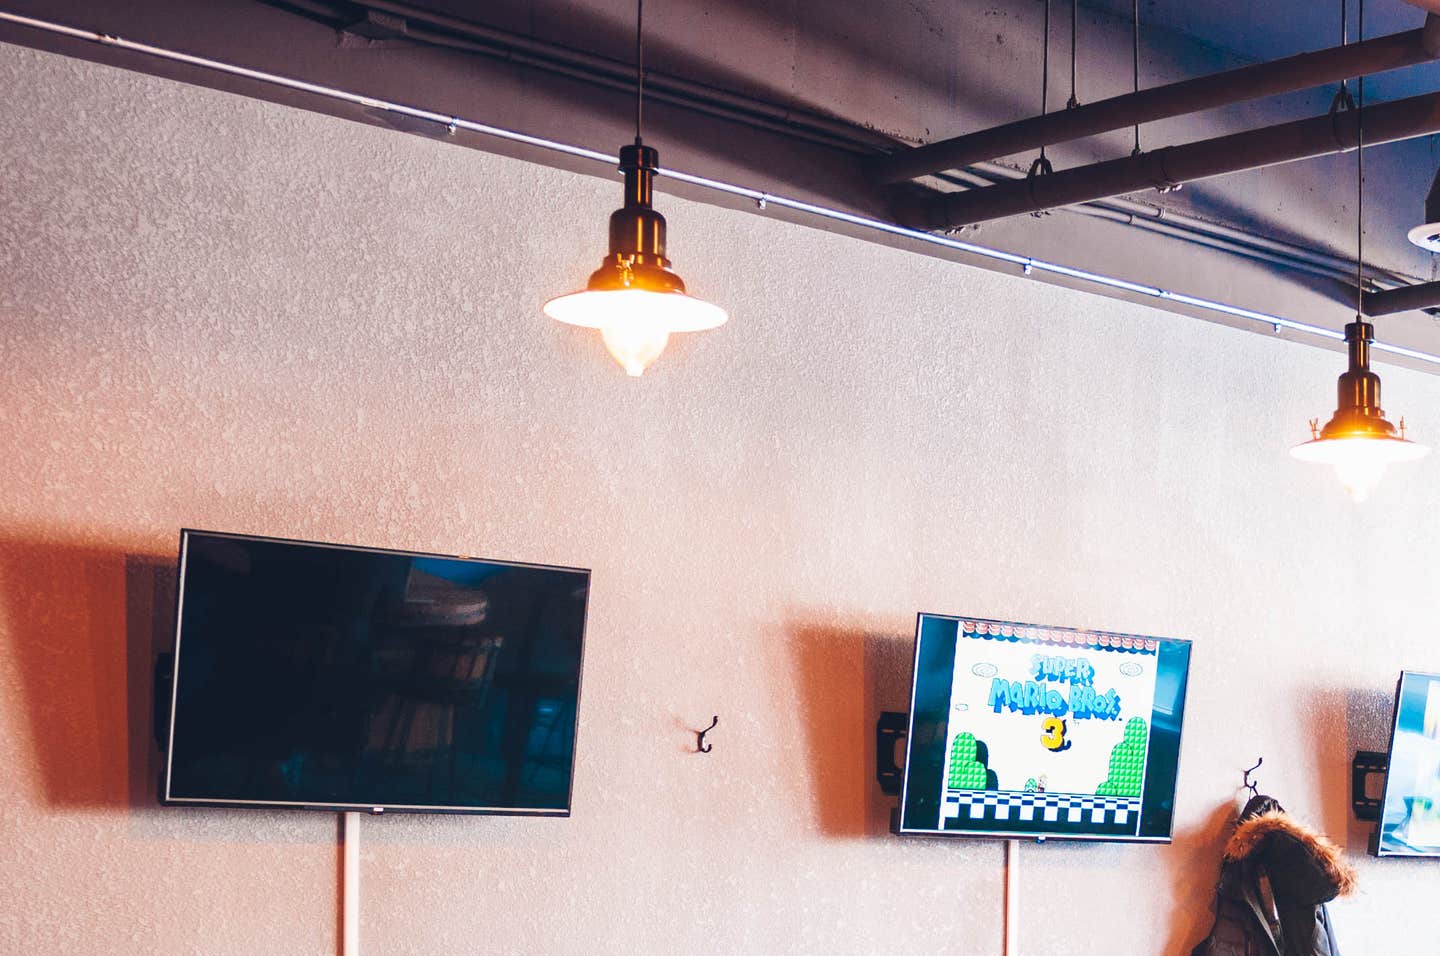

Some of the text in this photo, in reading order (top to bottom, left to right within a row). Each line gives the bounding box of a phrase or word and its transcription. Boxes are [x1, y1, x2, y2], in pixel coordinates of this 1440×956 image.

[1030, 654, 1094, 684] SUPER
[988, 678, 1068, 716] MARIO
[1040, 717, 1067, 751] 3
